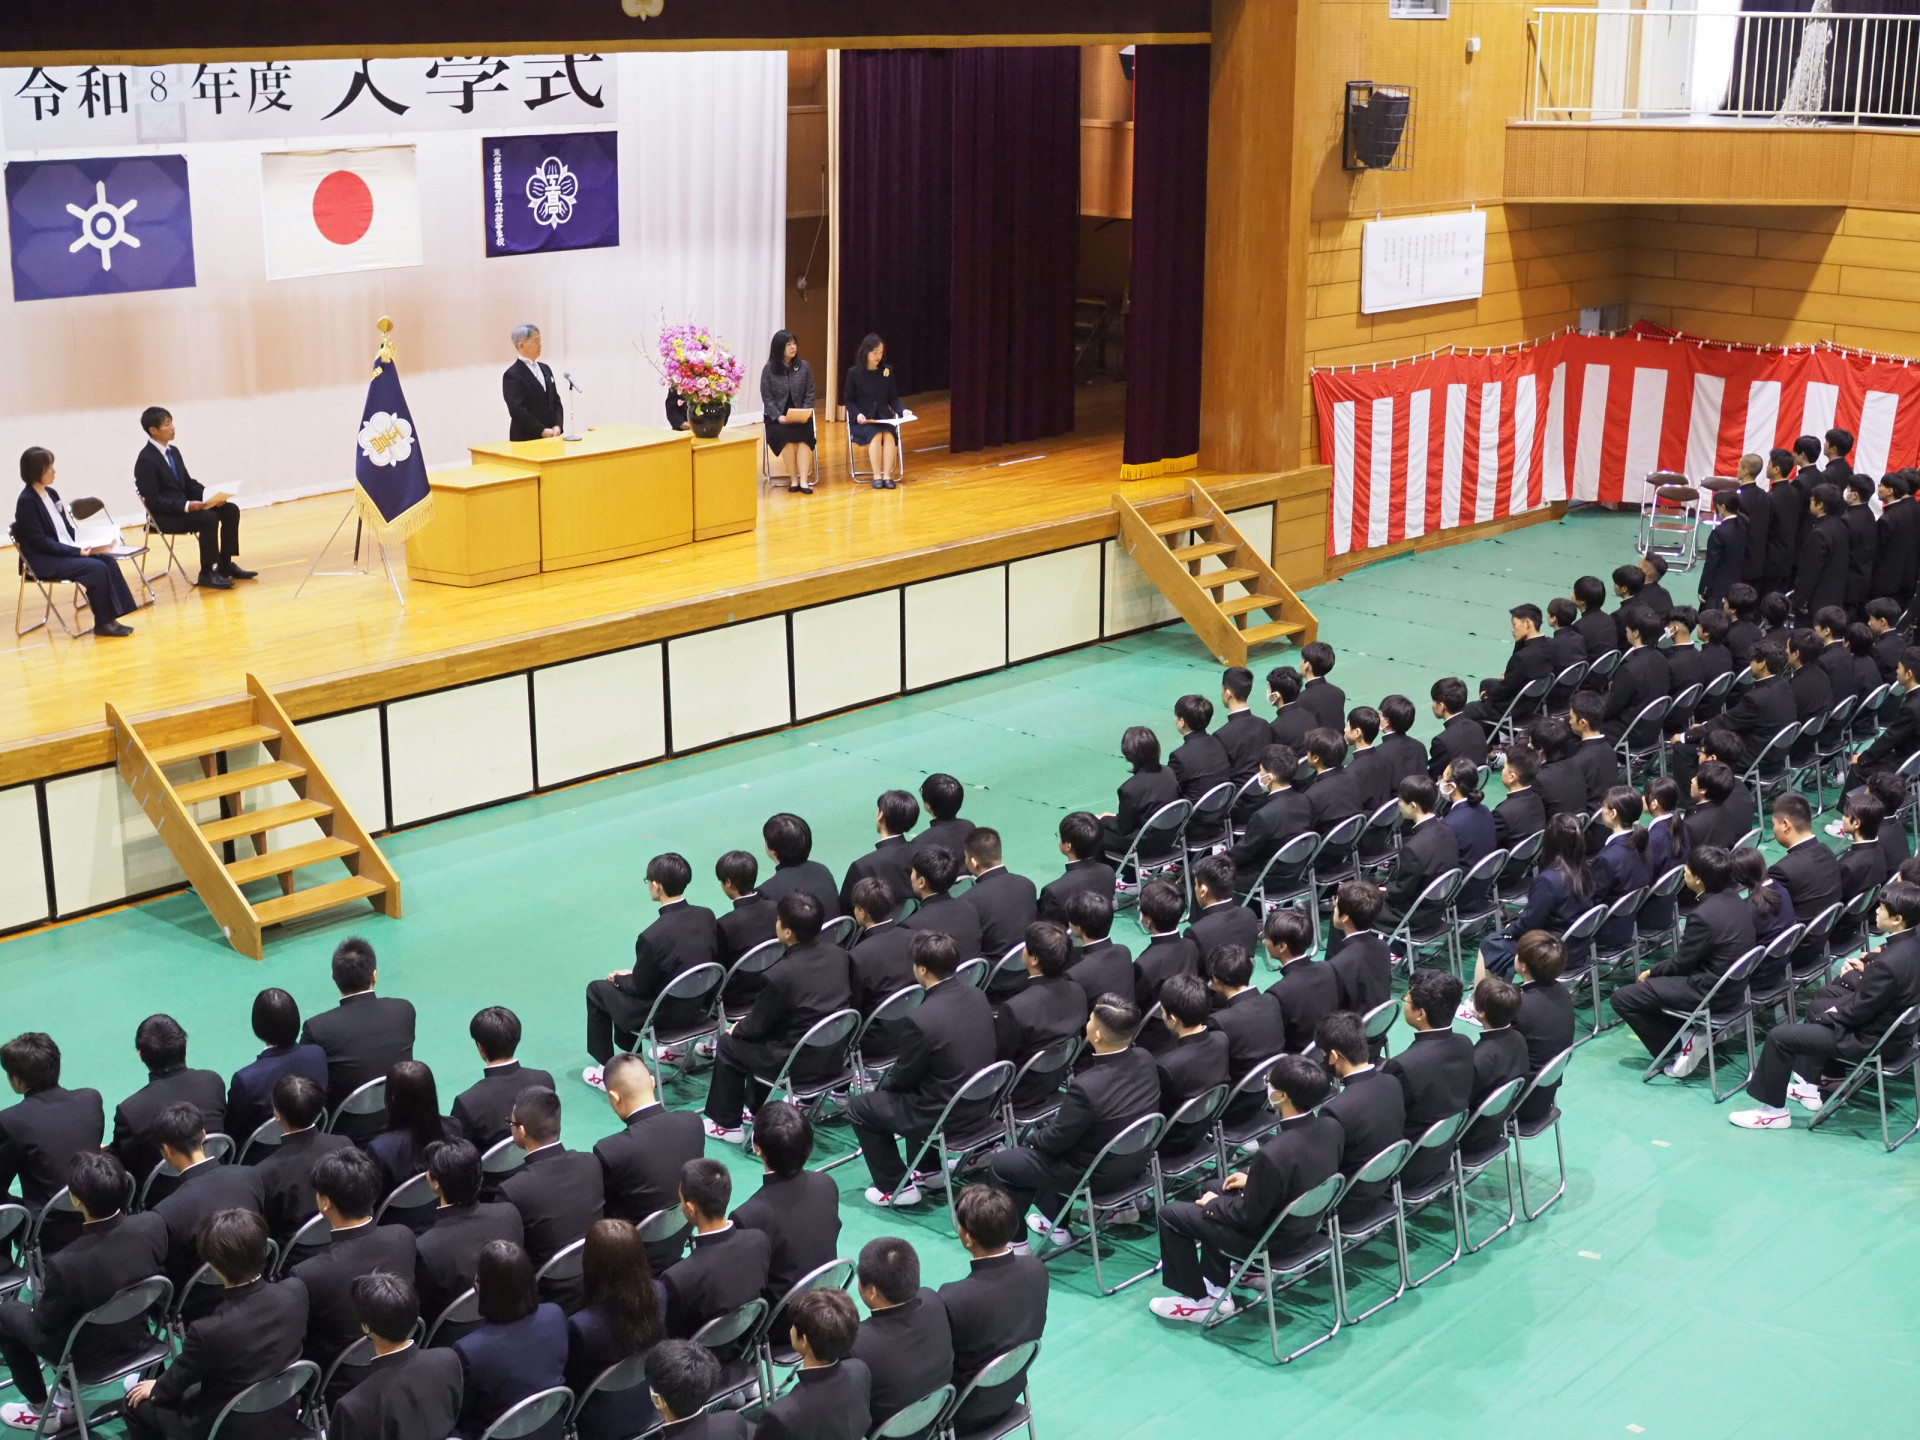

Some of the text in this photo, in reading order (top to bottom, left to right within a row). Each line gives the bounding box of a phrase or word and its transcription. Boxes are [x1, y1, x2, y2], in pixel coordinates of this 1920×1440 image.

[14, 54, 605, 121] 令和8年度 入学式
